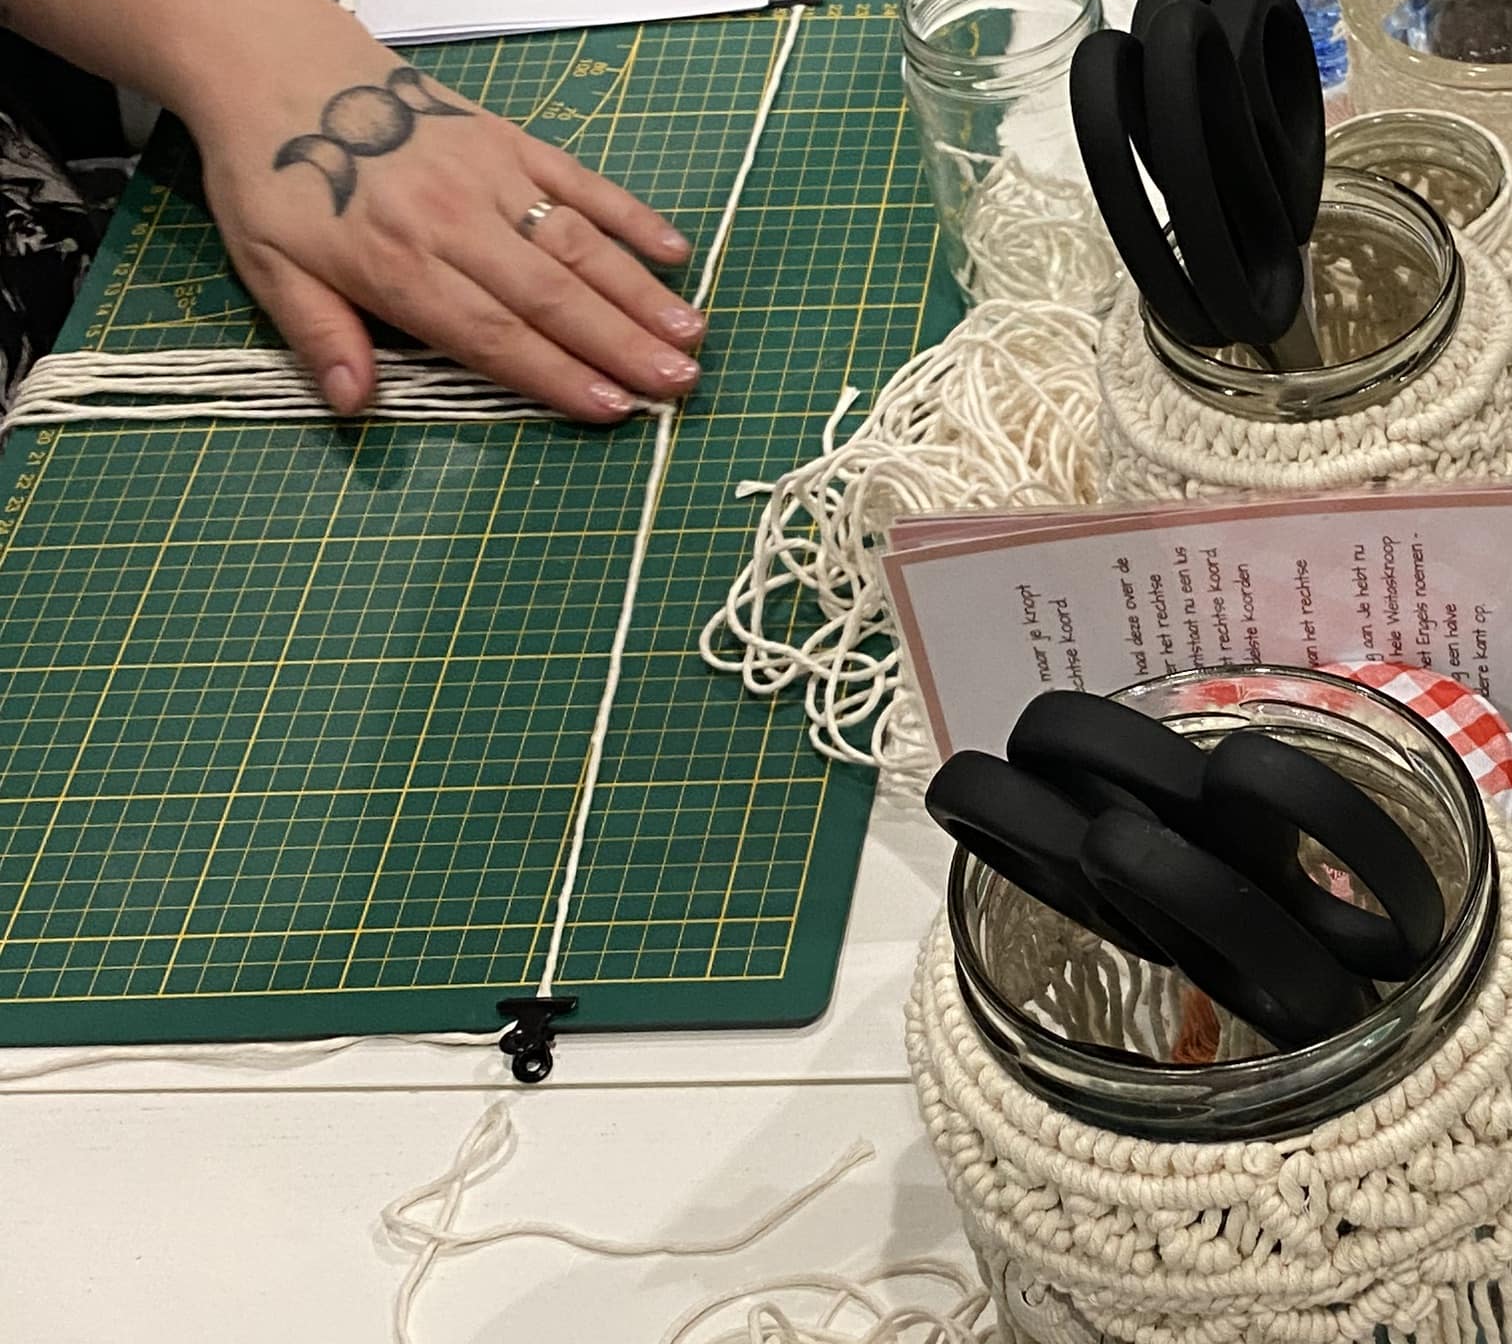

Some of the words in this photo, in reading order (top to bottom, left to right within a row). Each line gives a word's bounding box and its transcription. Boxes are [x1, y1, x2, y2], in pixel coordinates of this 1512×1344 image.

[1112, 556, 1130, 574] de
[1172, 545, 1188, 566] lus
[1353, 544, 1366, 561] nu
[1176, 568, 1193, 594] een
[1351, 567, 1370, 598] hebt
[1410, 542, 1427, 598] noemen
[1120, 577, 1137, 610] over
[1148, 573, 1169, 628] rechtse
[1232, 563, 1255, 623] koorden
[1293, 559, 1314, 615] rechtse
[1016, 584, 1041, 625] knopt
[1183, 601, 1196, 616] nu
[1029, 628, 1051, 642] je
[1124, 615, 1144, 646] deze
[1211, 596, 1233, 651] rechtse
[1299, 620, 1318, 643] het
[1414, 602, 1438, 646] Engels
[1442, 603, 1458, 639] halve
[1157, 633, 1174, 656] het
[1388, 631, 1404, 663] hele
[1446, 640, 1461, 667] een
[1471, 624, 1490, 660] kant
[1033, 646, 1052, 682] maar
[1130, 650, 1149, 676] haal
